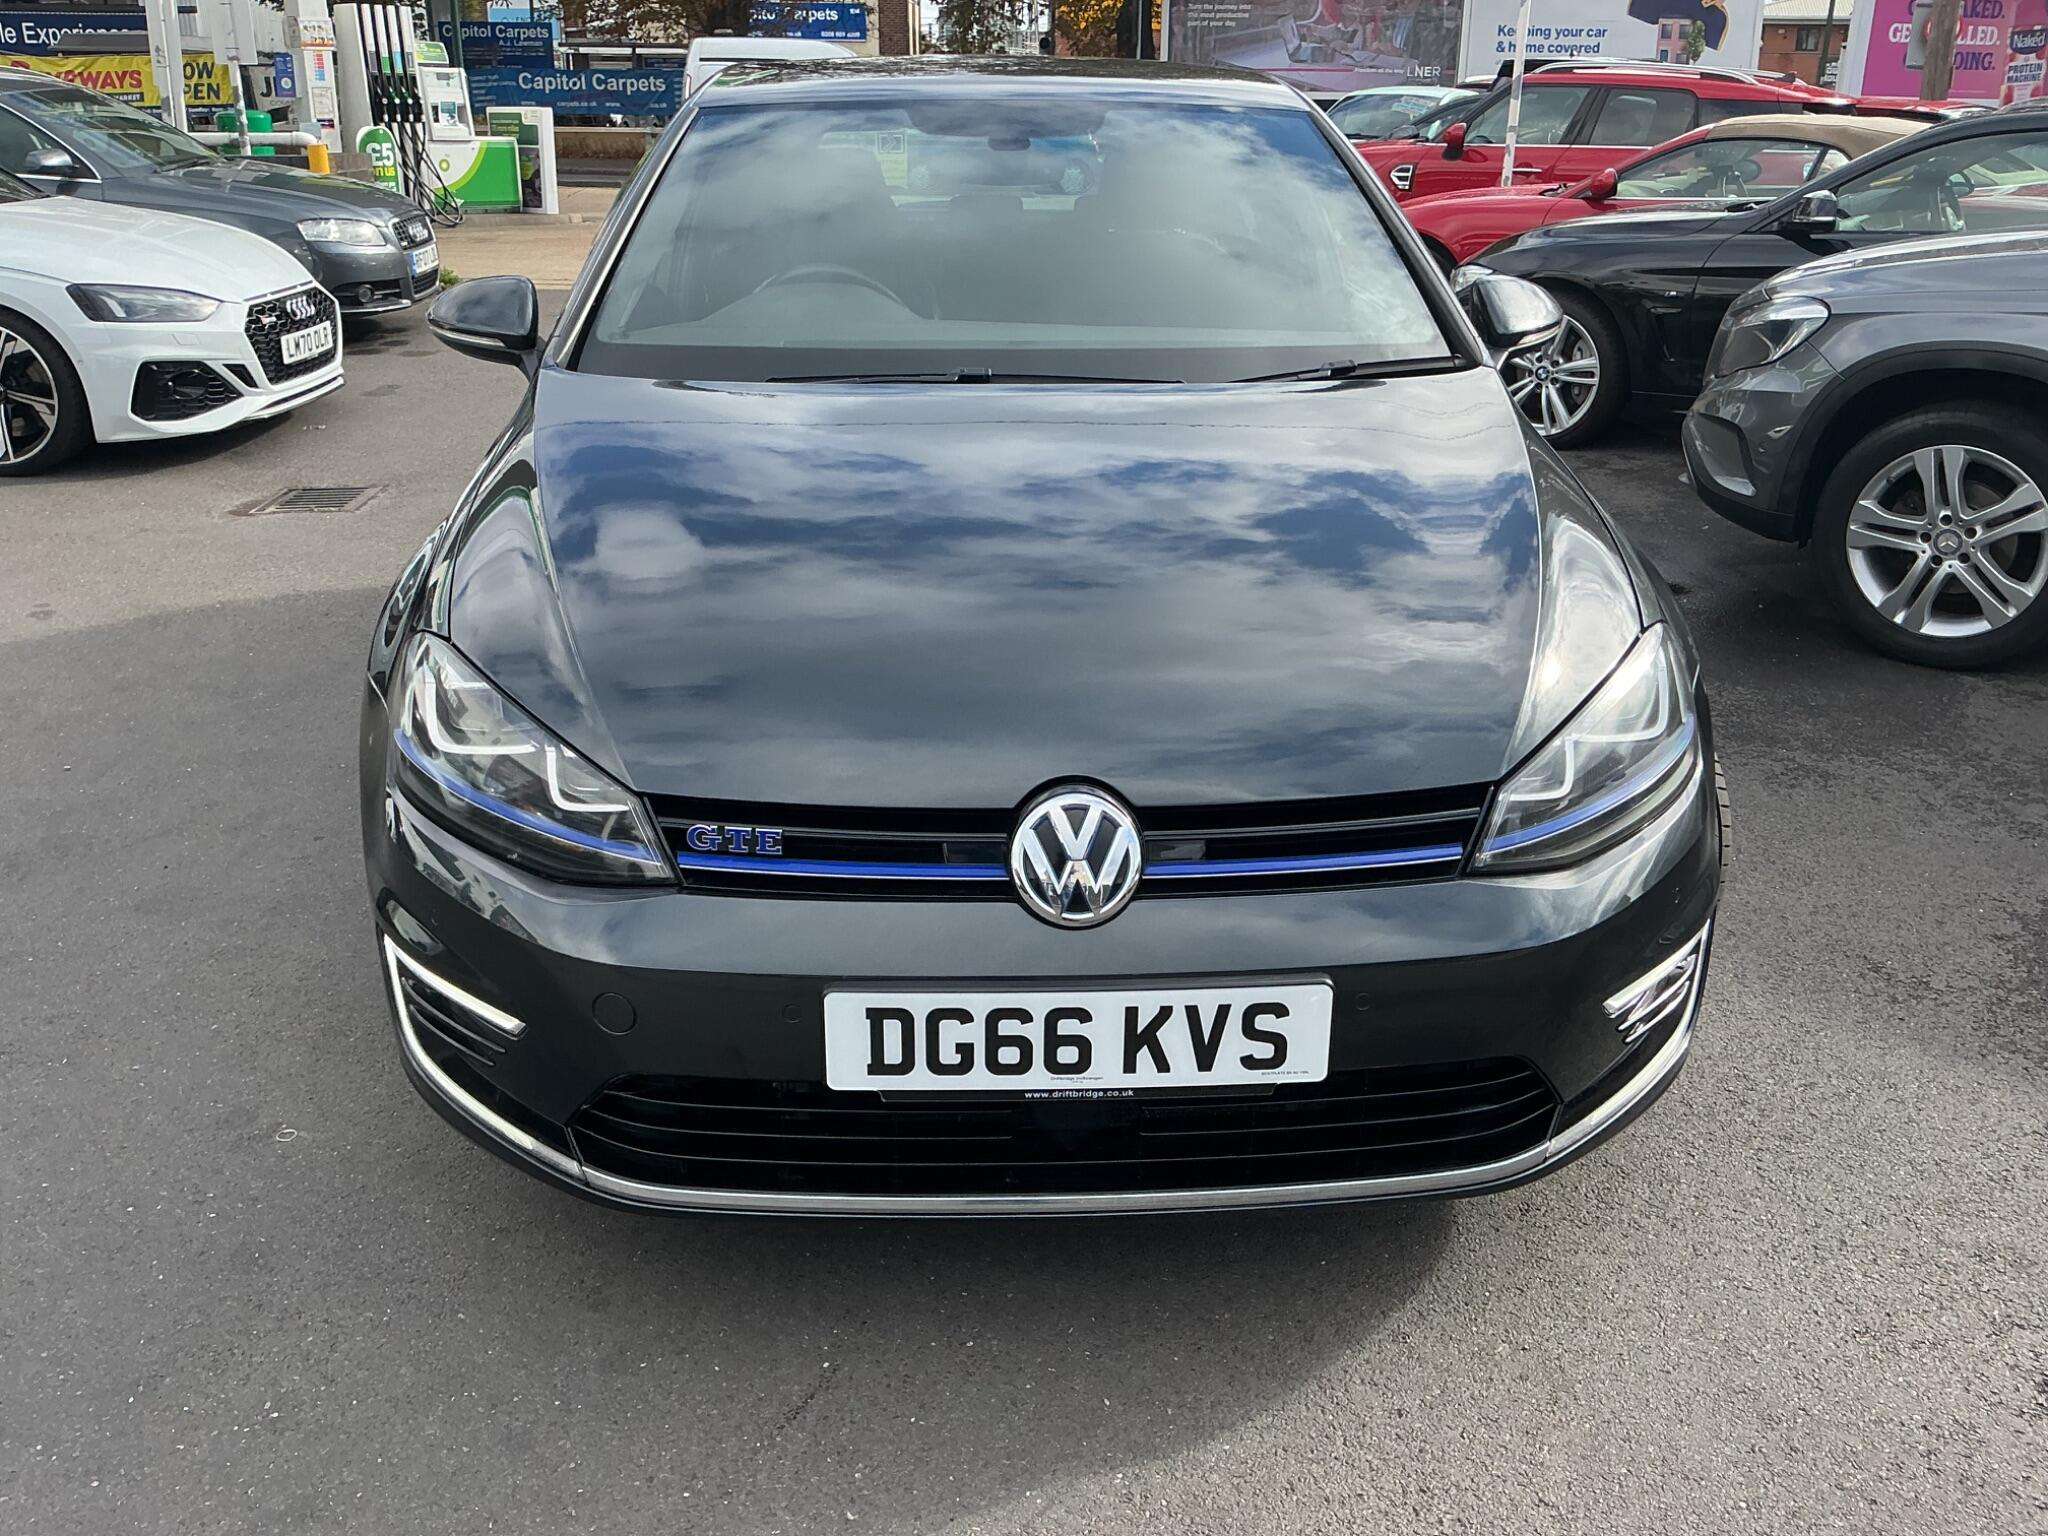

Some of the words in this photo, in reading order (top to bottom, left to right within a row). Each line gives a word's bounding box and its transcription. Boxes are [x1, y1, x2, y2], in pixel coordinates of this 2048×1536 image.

[1963, 0, 2005, 19] KED.
[442, 24, 491, 41] Cpitol
[495, 25, 549, 40] Carpets
[1497, 25, 1551, 40] Keing
[1554, 27, 1584, 40] your
[1586, 29, 1608, 38] car
[1956, 25, 2000, 45] LLED.
[2012, 32, 2046, 48] Naked
[1496, 41, 1505, 53] &
[1508, 41, 1544, 53] hme
[1547, 42, 1600, 54] covered
[1953, 51, 1995, 70] OING.
[2008, 62, 2043, 75] PROTEIN
[183, 62, 214, 80] OW
[1407, 64, 1441, 78] LNER
[183, 82, 220, 100] PEN
[518, 72, 587, 94] Capitol
[592, 74, 666, 95] Carpets
[366, 142, 394, 167] £5
[286, 332, 313, 357] LM70
[687, 824, 783, 855] GTE
[865, 1006, 1092, 1077] DG66
[1122, 1001, 1291, 1075] KVS
[1024, 1089, 1134, 1099] www.driftbridge.co.uk
